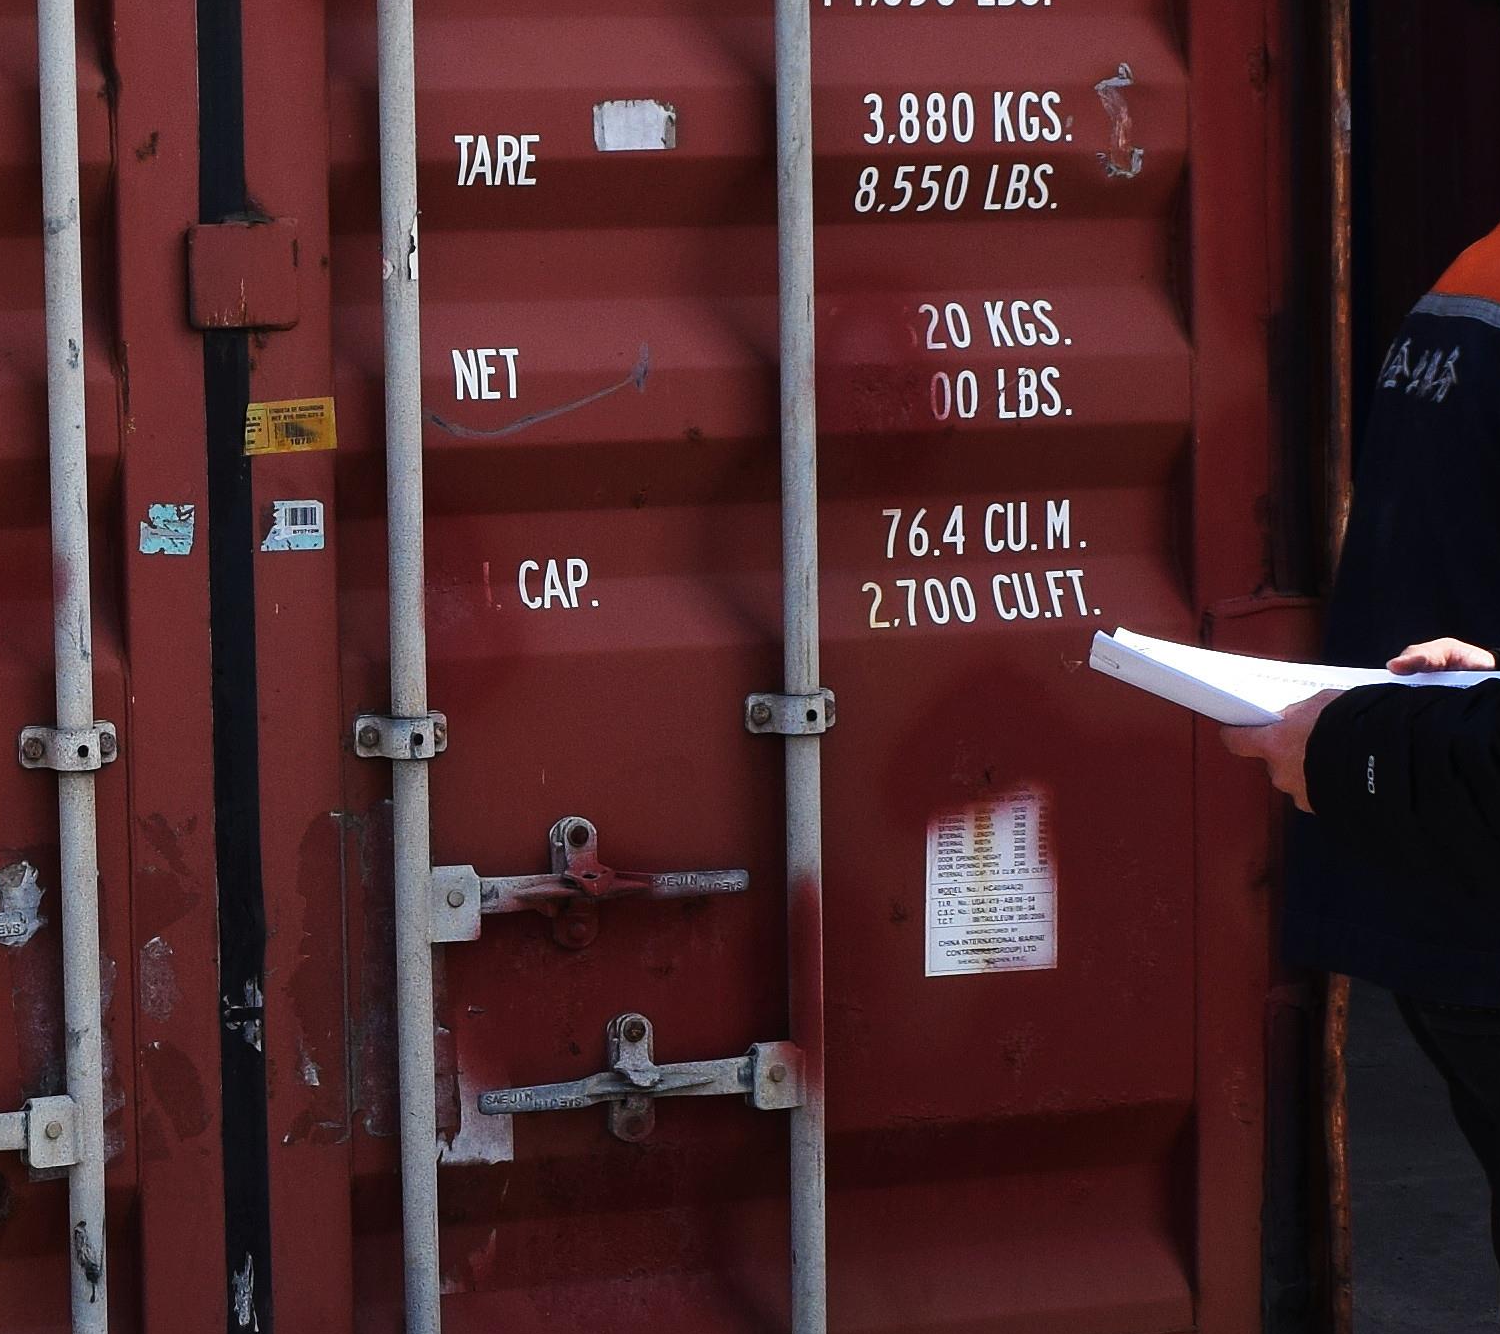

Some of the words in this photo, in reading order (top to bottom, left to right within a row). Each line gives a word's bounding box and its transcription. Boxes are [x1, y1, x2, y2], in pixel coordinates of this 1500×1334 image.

[993, 90, 1073, 143] KGS.
[454, 134, 541, 187] TARE
[983, 163, 1058, 211] LBS.
[983, 299, 1073, 348] KGS.
[452, 348, 521, 401] NET
[997, 366, 1073, 419] LBS.
[882, 504, 966, 560] 76.4
[518, 558, 600, 610] CAP.
[484, 1090, 533, 1105] SAEJIN
